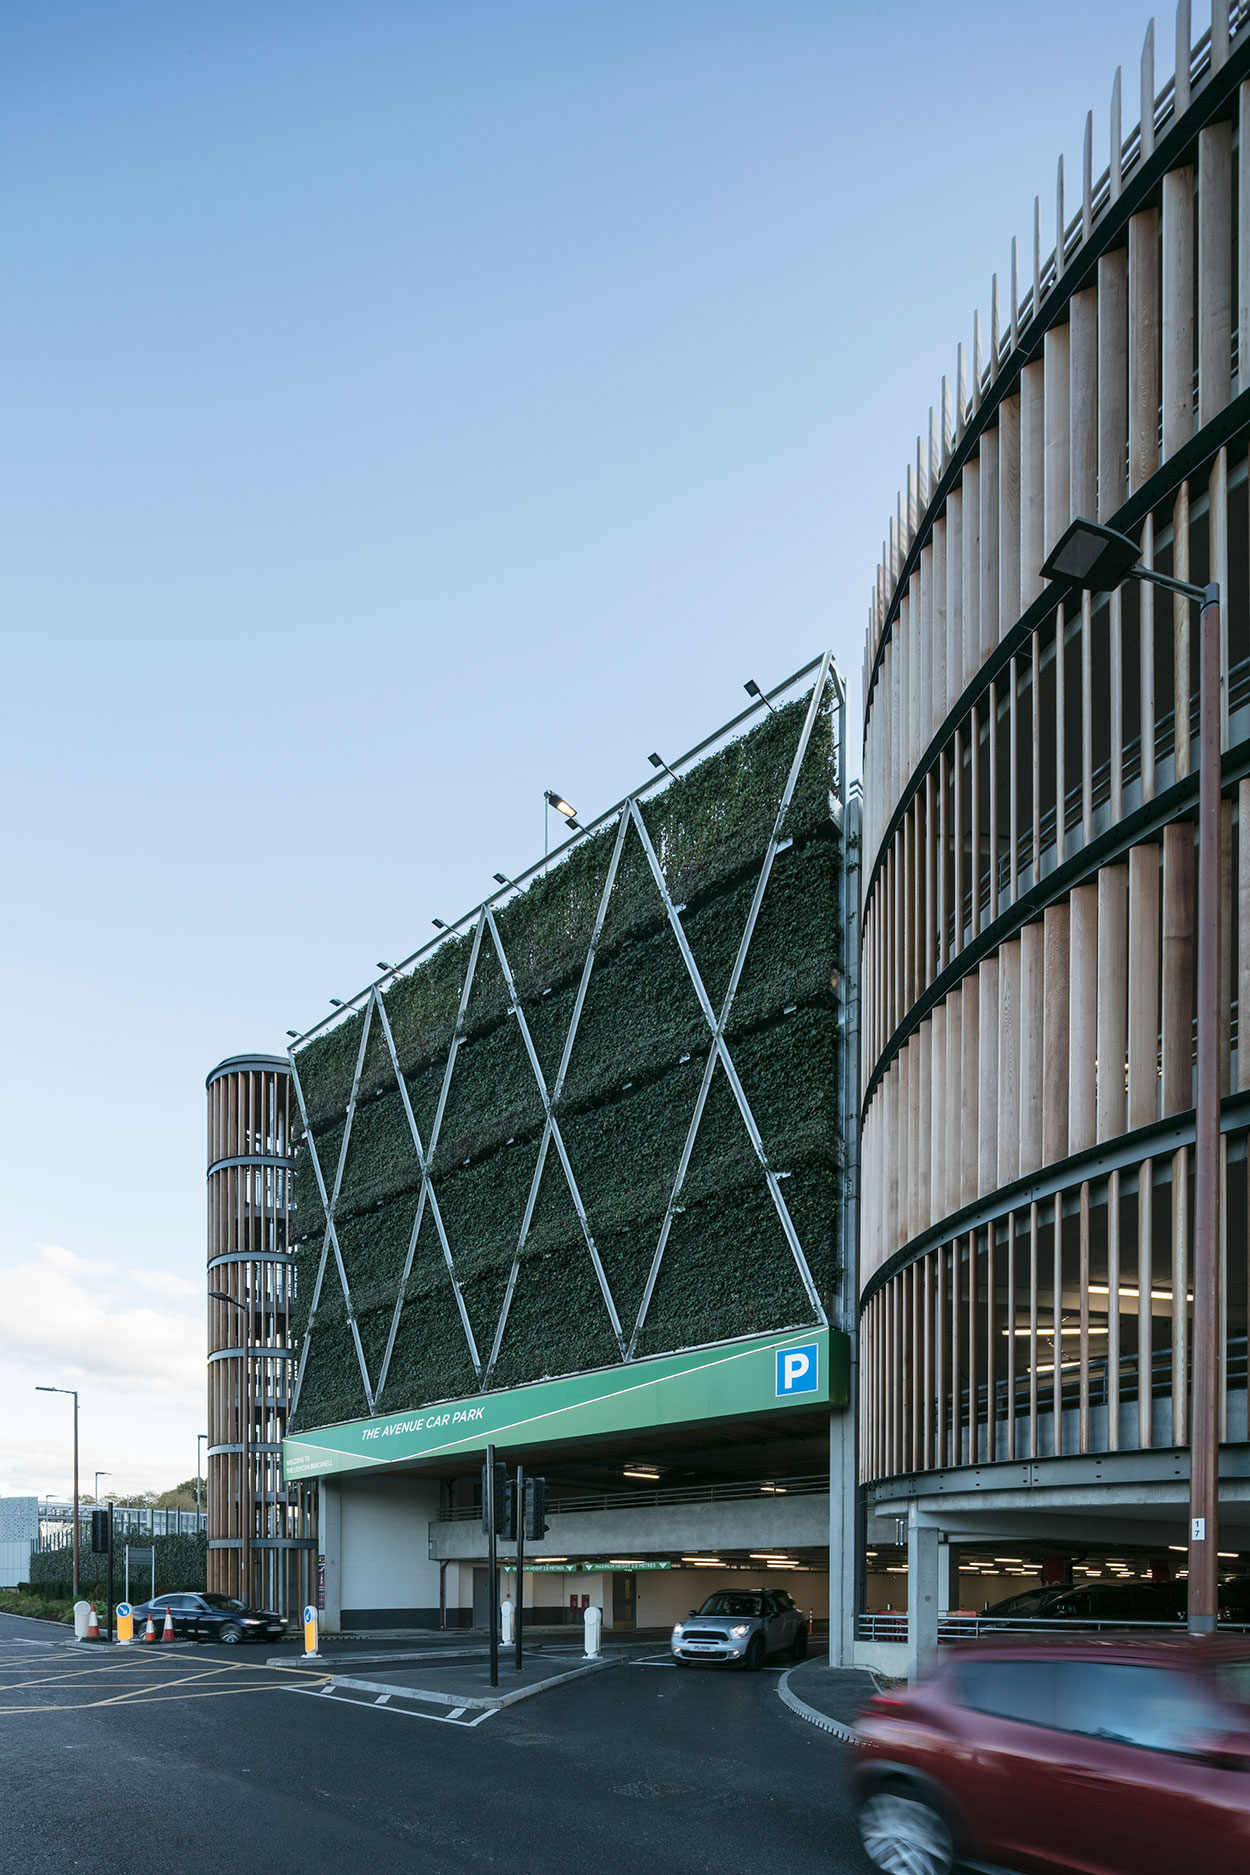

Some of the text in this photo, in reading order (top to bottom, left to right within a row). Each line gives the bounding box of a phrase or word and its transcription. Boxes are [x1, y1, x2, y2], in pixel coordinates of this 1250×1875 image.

[784, 1353, 809, 1389] P
[361, 1406, 486, 1440] THE AVENUE CAR PARK
[286, 1456, 304, 1466] WELCOME
